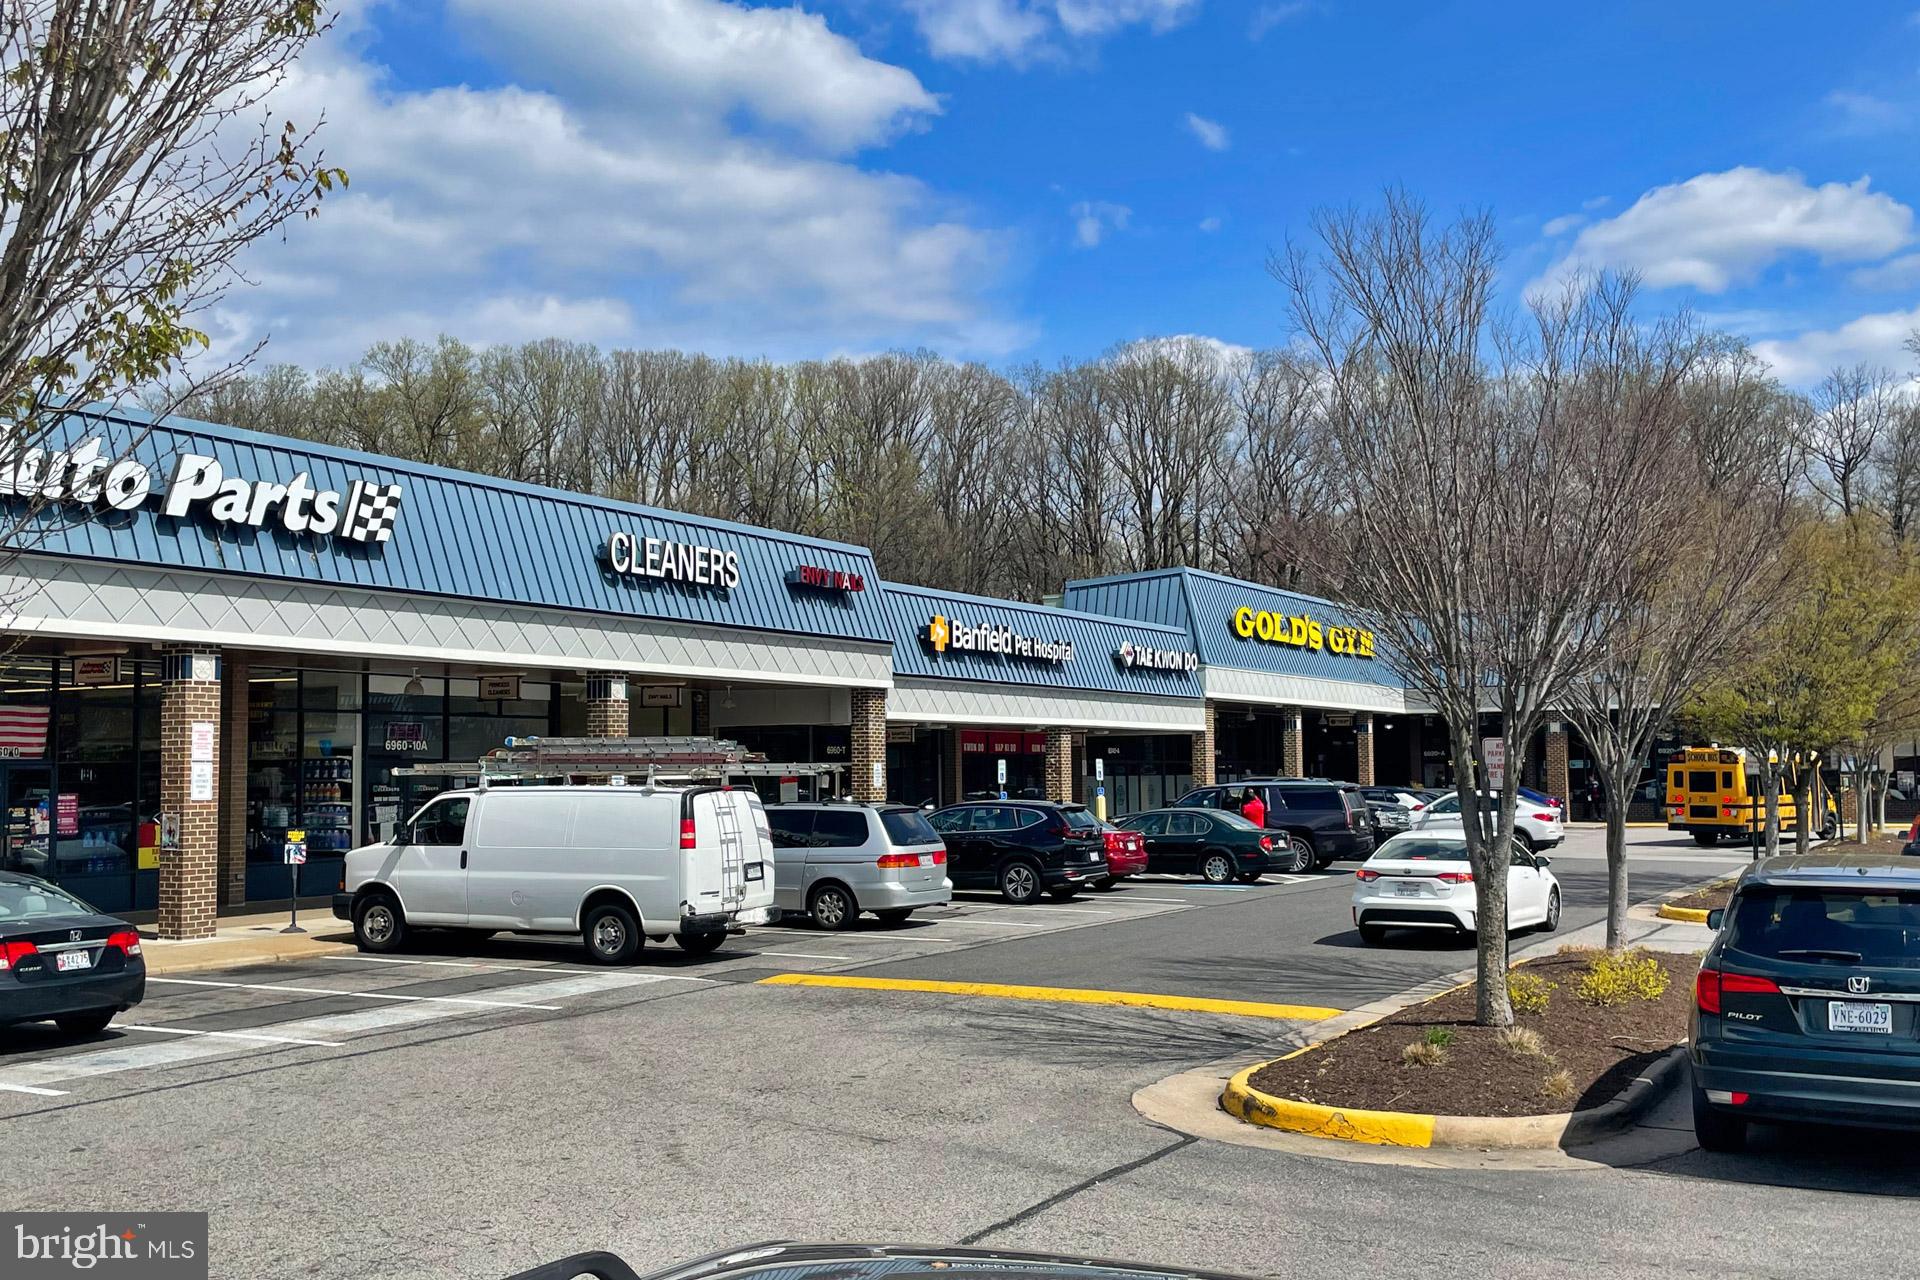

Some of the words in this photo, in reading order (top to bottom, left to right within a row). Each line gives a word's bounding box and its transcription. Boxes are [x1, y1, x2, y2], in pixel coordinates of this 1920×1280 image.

[165, 453, 341, 535] Parts
[609, 531, 740, 589] CLEANERS
[801, 564, 830, 586] ENVY
[834, 570, 865, 592] NAILS
[951, 619, 1013, 654] Banfield
[1015, 634, 1033, 657] Pet
[1034, 637, 1074, 664] Hospital
[1234, 605, 1324, 651] GOLD'S
[1328, 625, 1377, 658] GYM
[1134, 645, 1153, 667] TAE
[1154, 648, 1183, 670] KWON
[1184, 652, 1198, 672] DO
[385, 740, 428, 751] 6960-10A
[1687, 752, 1705, 762] SCHOOL
[1707, 752, 1718, 762] BUS
[1727, 1011, 1763, 1021] PILOT
[1833, 1009, 1888, 1025] VNE-6029
